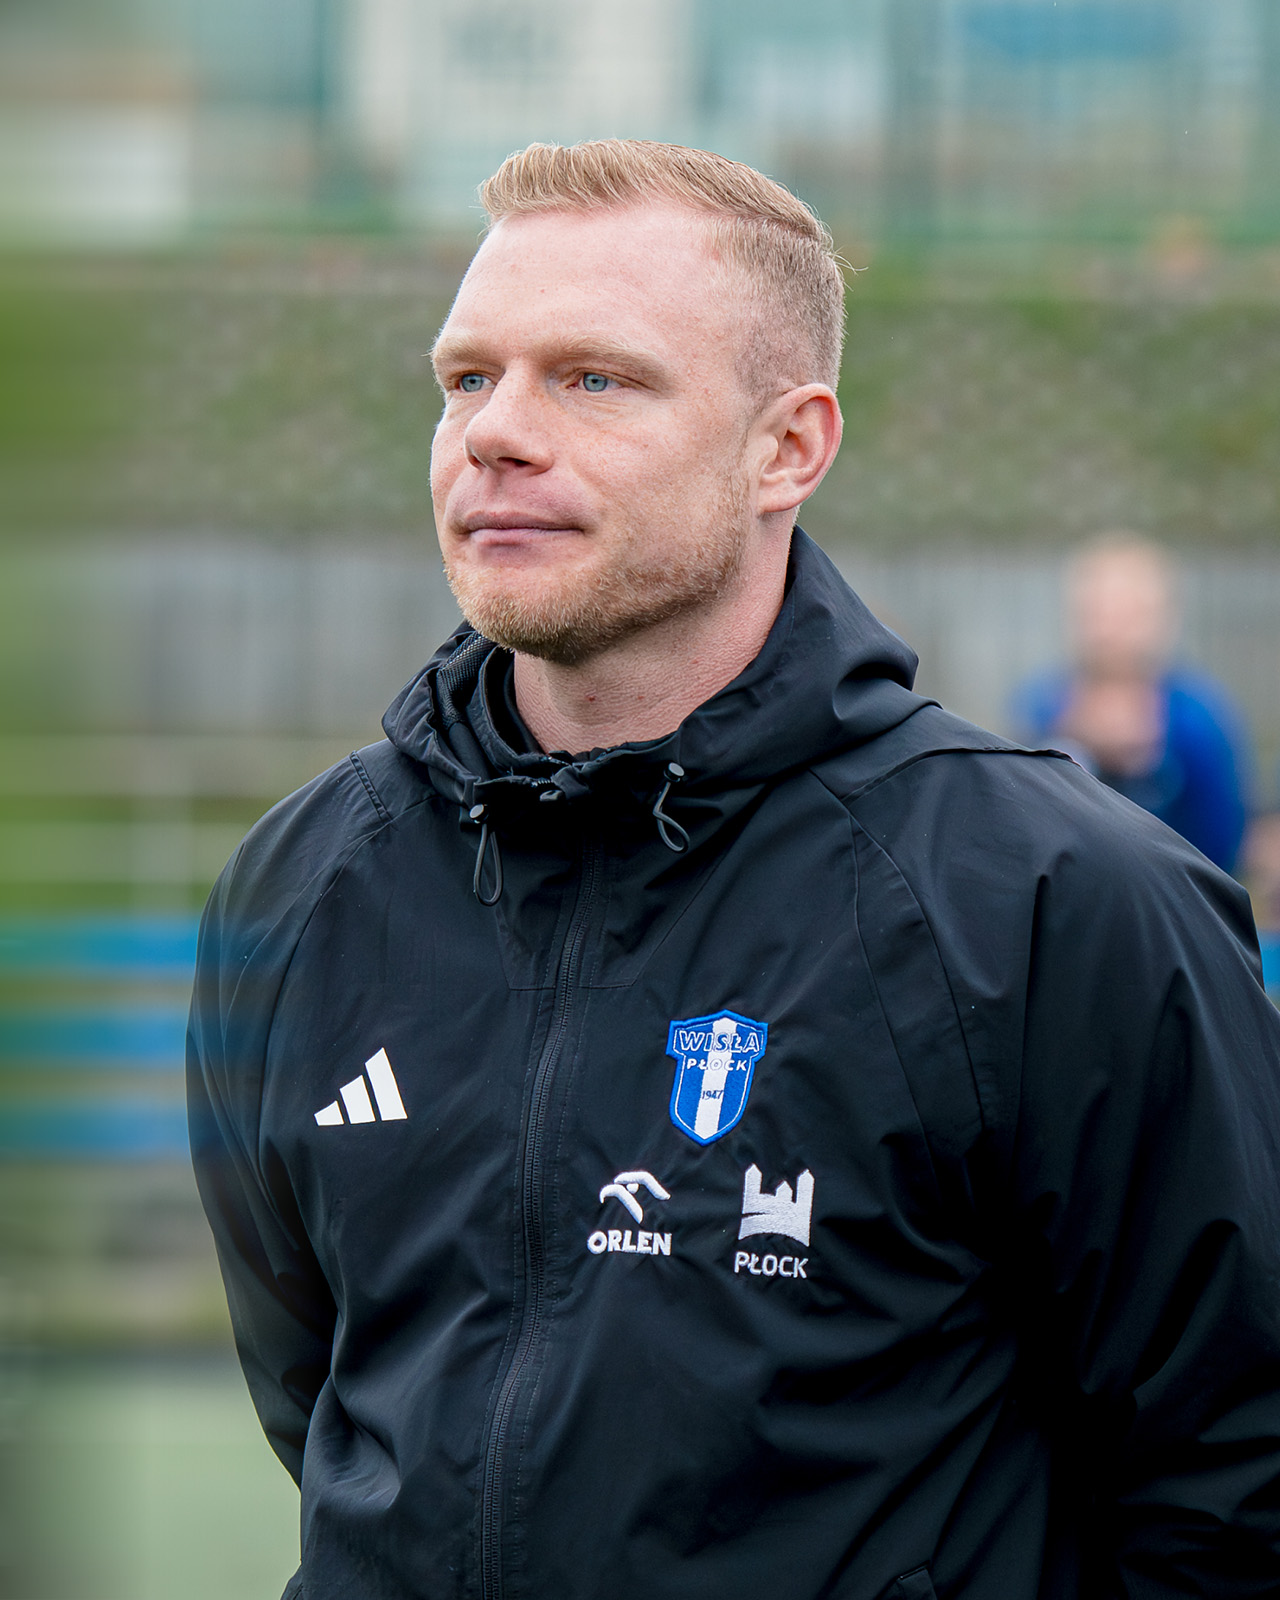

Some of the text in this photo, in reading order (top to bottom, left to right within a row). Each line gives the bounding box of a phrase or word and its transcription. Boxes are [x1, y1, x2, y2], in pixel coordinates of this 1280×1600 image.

[679, 1030, 760, 1053] WISŁA
[686, 1058, 747, 1071] PŁOCK
[701, 1089, 724, 1100] 1947
[587, 1229, 672, 1256] ORLEN
[733, 1251, 809, 1279] PŁOCK
